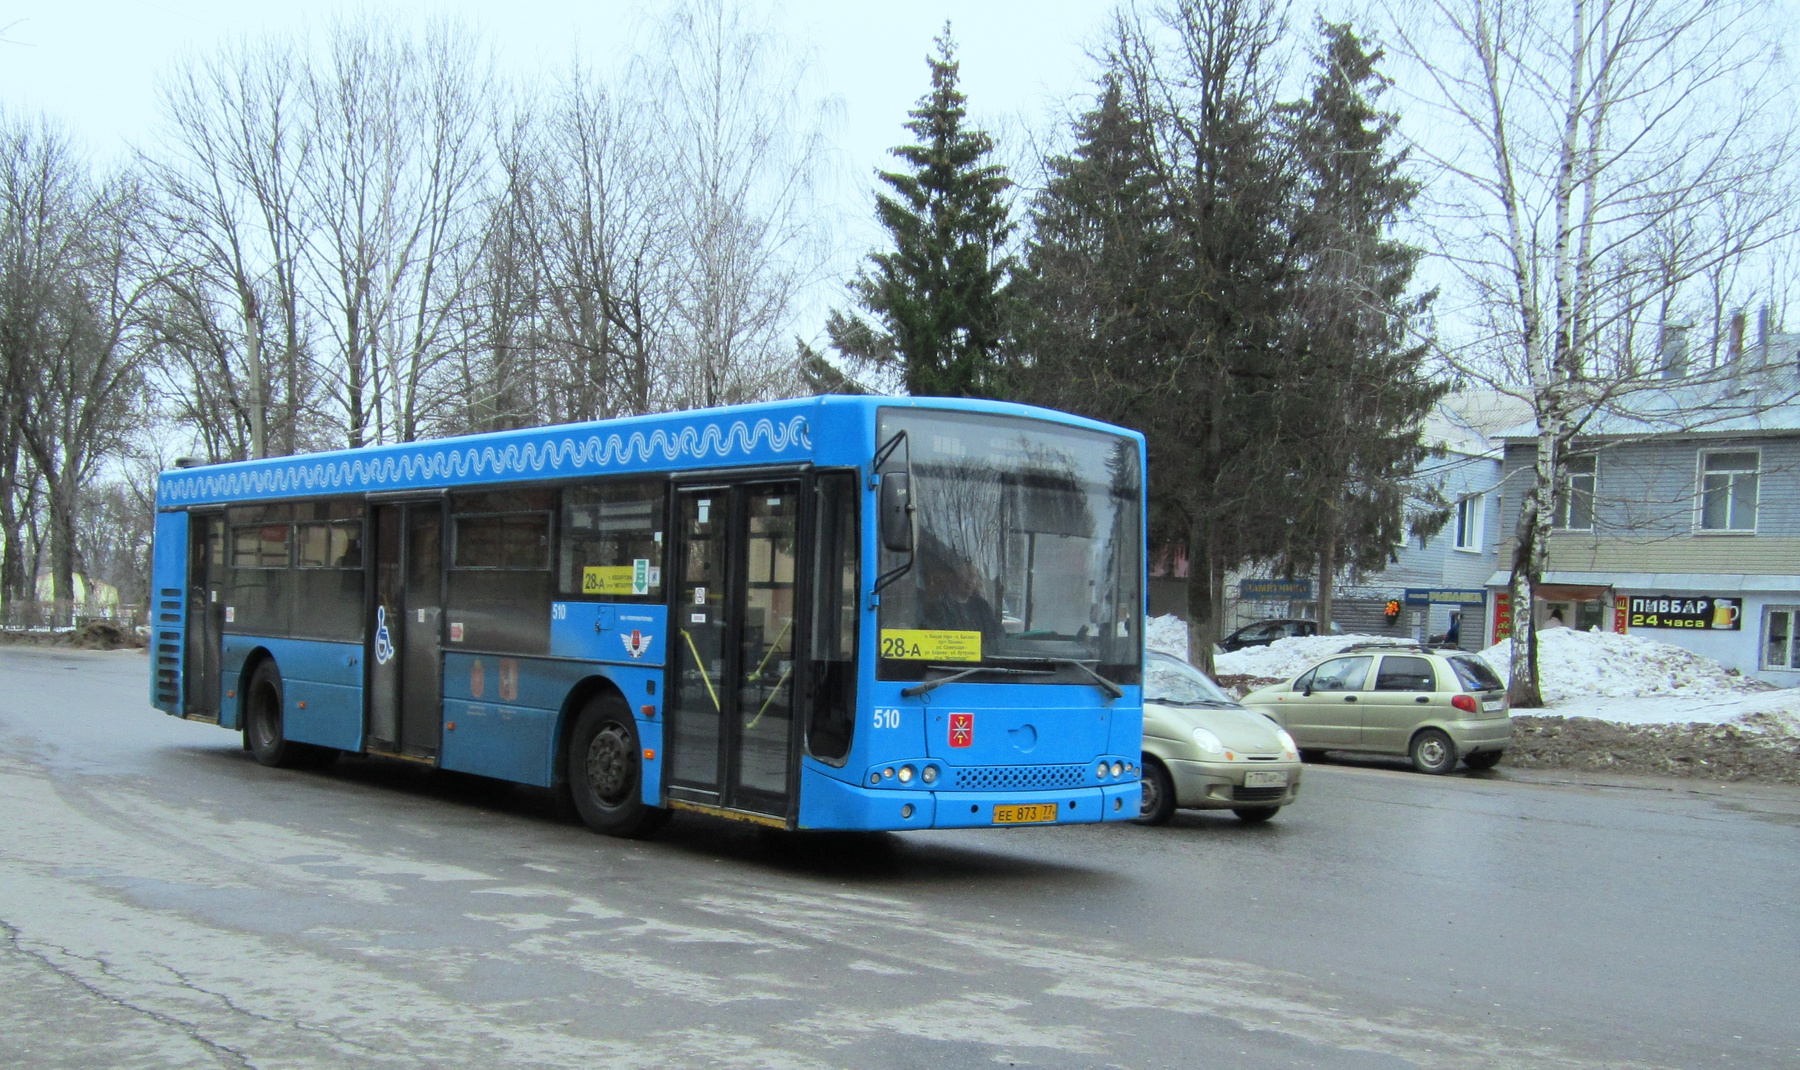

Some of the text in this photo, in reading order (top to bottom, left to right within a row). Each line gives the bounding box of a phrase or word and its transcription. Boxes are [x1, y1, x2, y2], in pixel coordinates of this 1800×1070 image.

[585, 573, 604, 590] 28-А
[552, 603, 566, 620] 510
[1632, 598, 1708, 614] ПИВБАР
[1632, 614, 1705, 628] 24 часа
[882, 638, 921, 657] 28-А
[873, 709, 900, 729] 510
[998, 805, 1052, 821] ЕЕ 873 77
